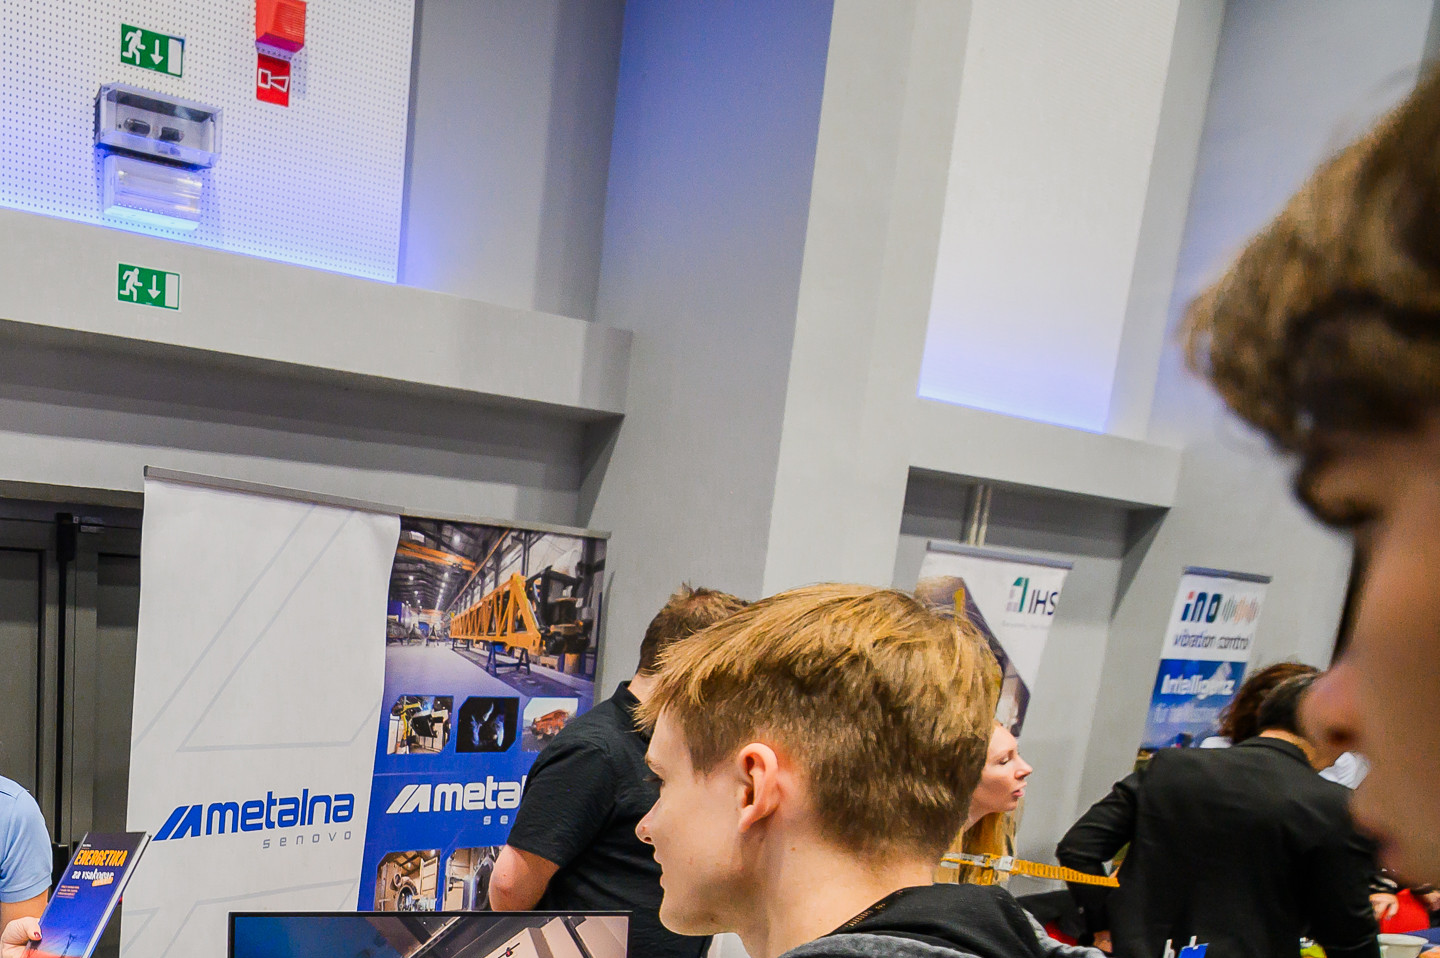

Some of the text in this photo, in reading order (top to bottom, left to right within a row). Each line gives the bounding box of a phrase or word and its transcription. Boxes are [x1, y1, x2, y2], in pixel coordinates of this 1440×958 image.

[1027, 589, 1058, 616] IHS
[433, 775, 527, 812] meta
[205, 788, 356, 836] metalna
[262, 830, 352, 849] senovo
[73, 849, 128, 867] ENERGETIKA
